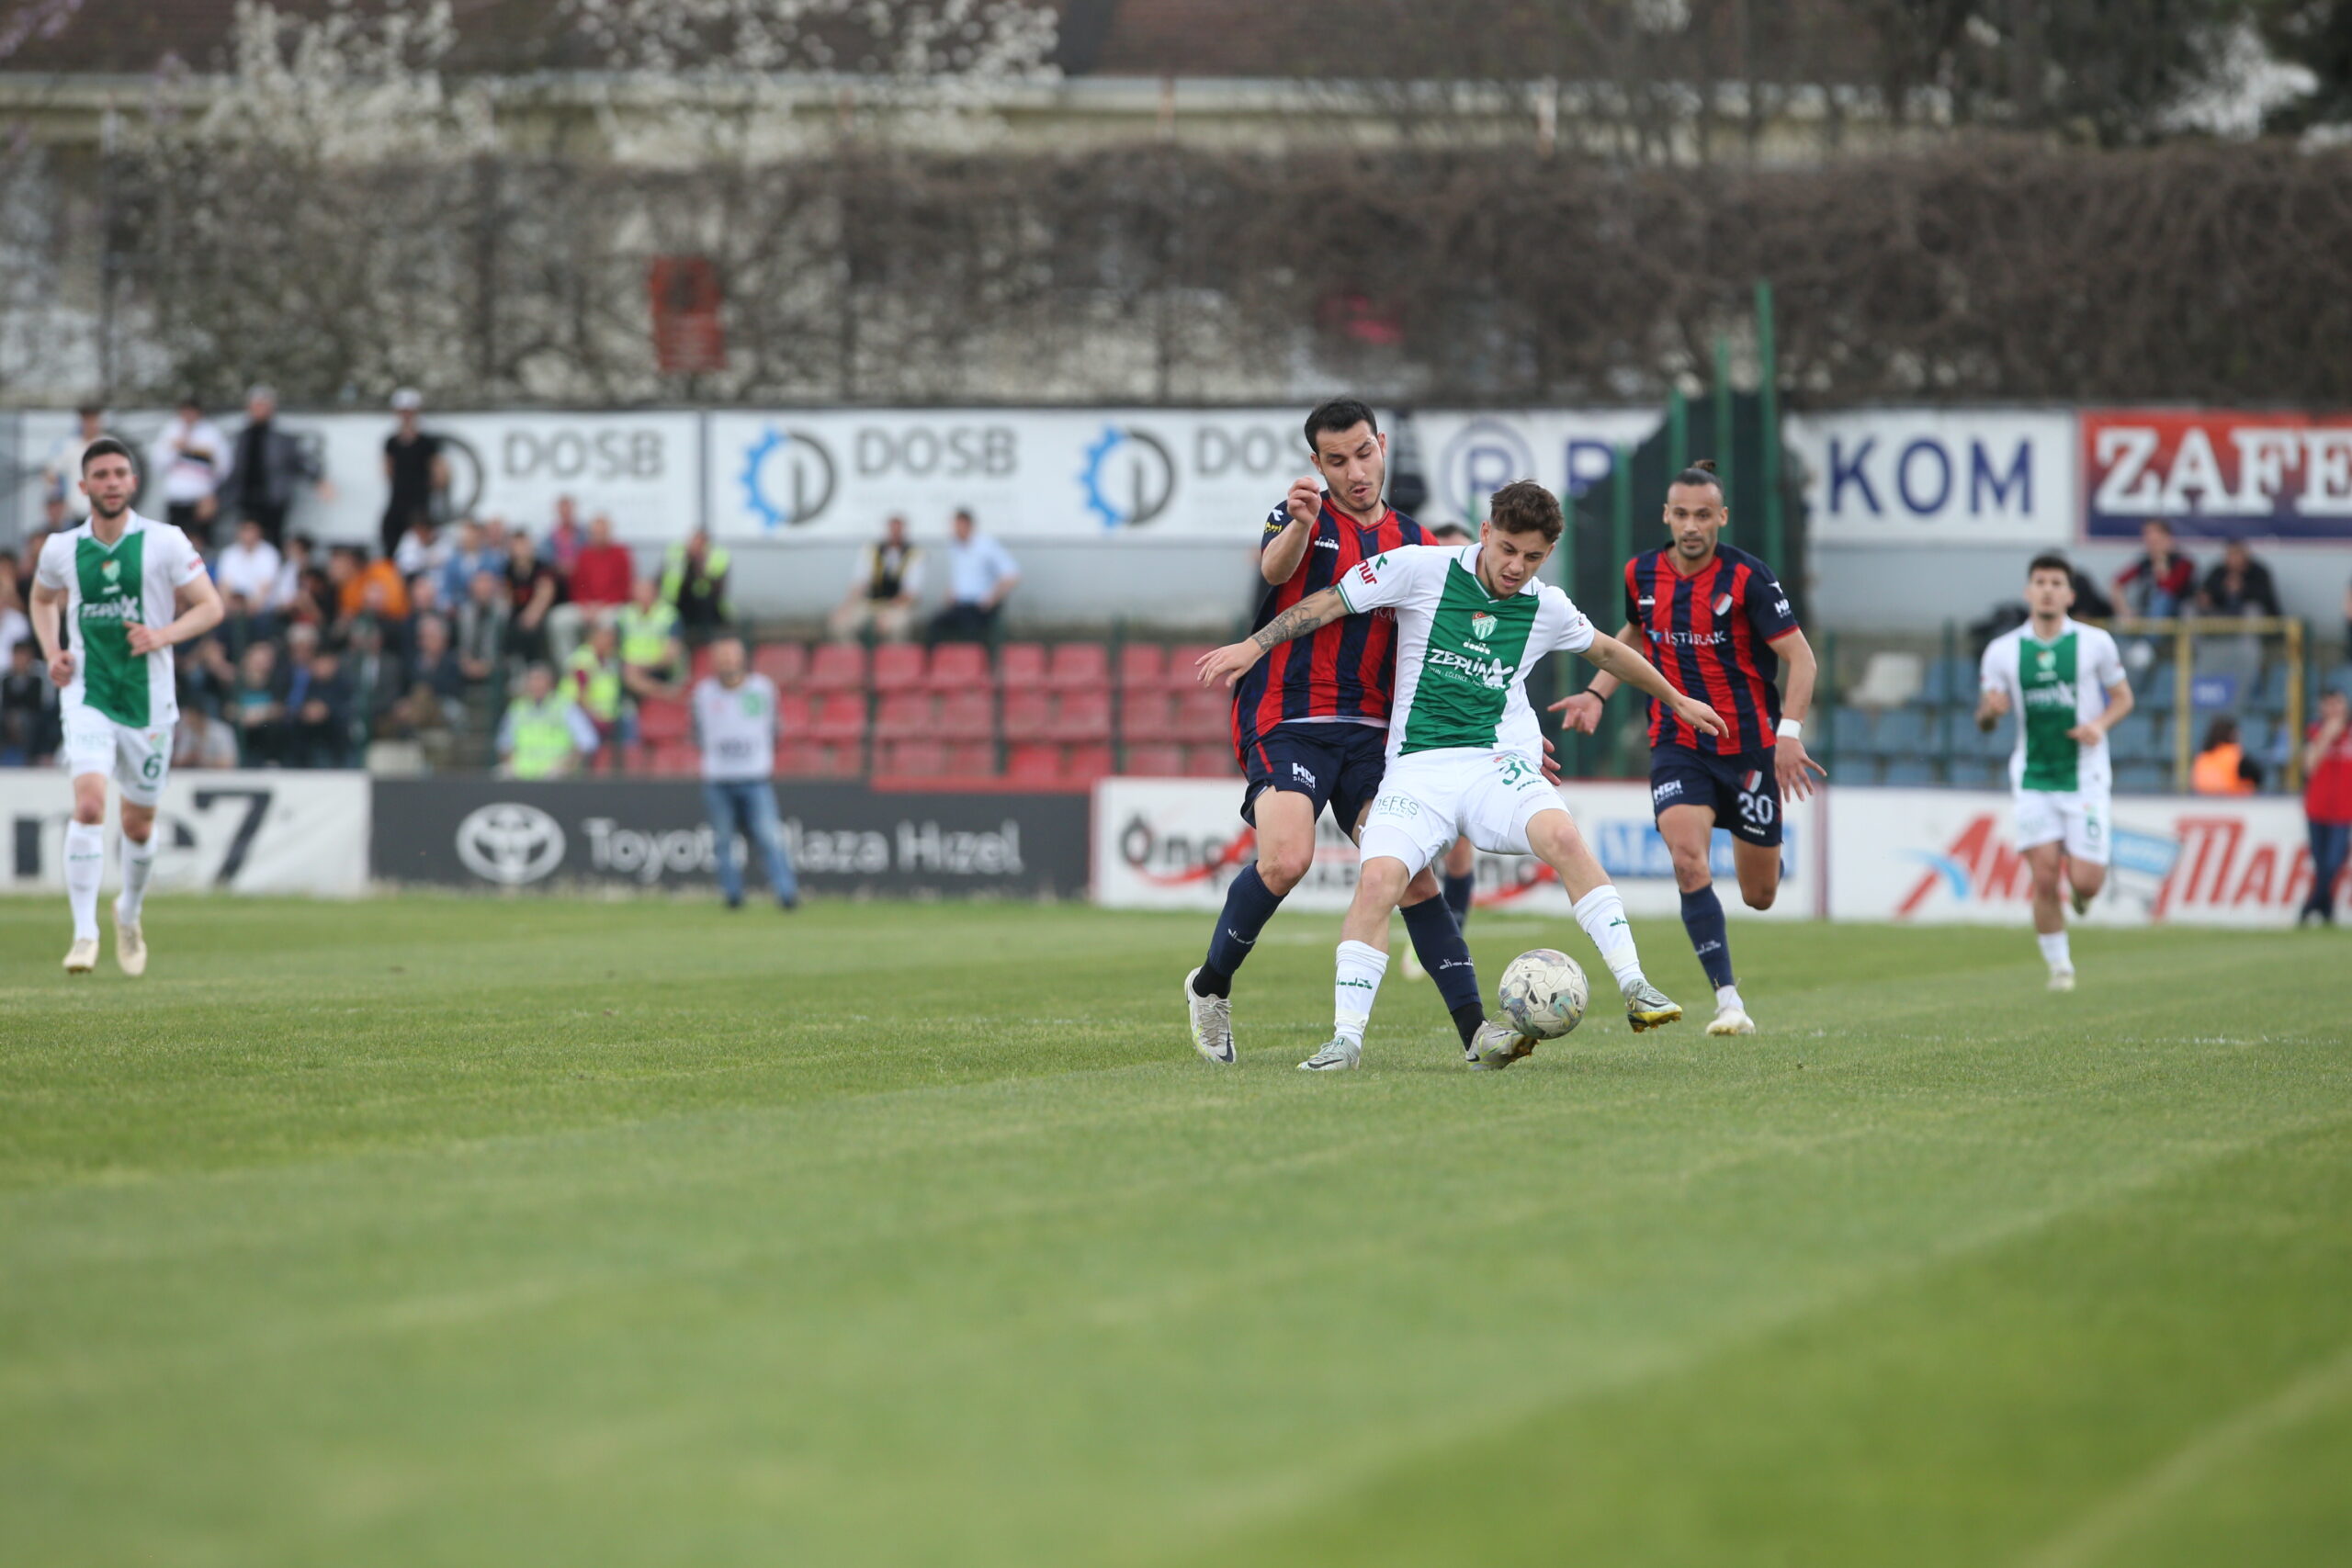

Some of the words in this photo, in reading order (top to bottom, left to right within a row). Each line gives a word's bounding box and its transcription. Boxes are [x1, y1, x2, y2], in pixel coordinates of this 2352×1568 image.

[504, 428, 664, 479] DOSB
[856, 426, 1019, 478] DOSB
[1196, 426, 1308, 477] DOS
[1828, 435, 2033, 516] KOM
[2094, 426, 2352, 517] ZAFE
[142, 752, 164, 780] 6
[1292, 762, 1316, 789] HDI
[1653, 779, 1682, 800] HDI
[1737, 792, 1774, 825] 20
